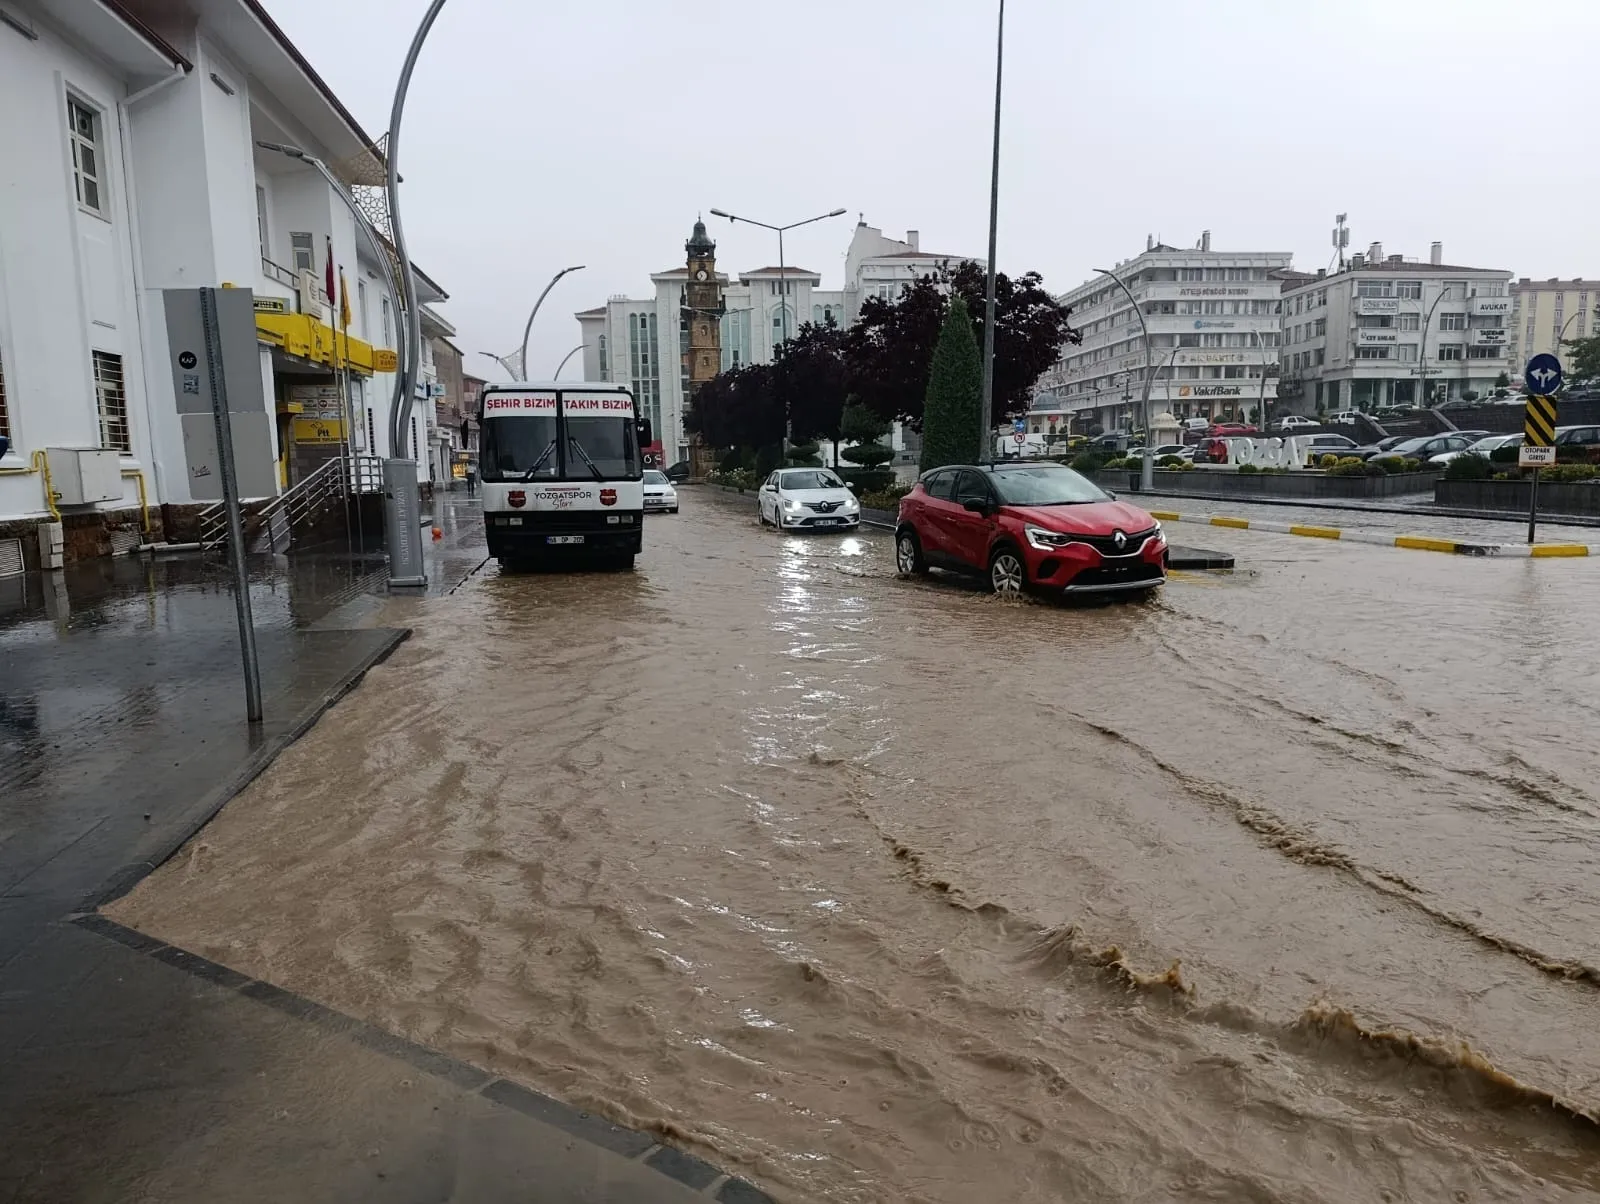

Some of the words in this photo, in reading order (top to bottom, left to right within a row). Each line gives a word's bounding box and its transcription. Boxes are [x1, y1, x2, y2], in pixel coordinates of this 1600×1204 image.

[1193, 386, 1241, 396] VakıfBank
[487, 398, 521, 410] ŞEHİR
[524, 398, 555, 408] BİZİM
[564, 400, 599, 409] TAKIM
[602, 400, 632, 410] BİZİM
[1226, 436, 1314, 465] YOZGAT
[534, 491, 592, 499] YOZGATSPOR
